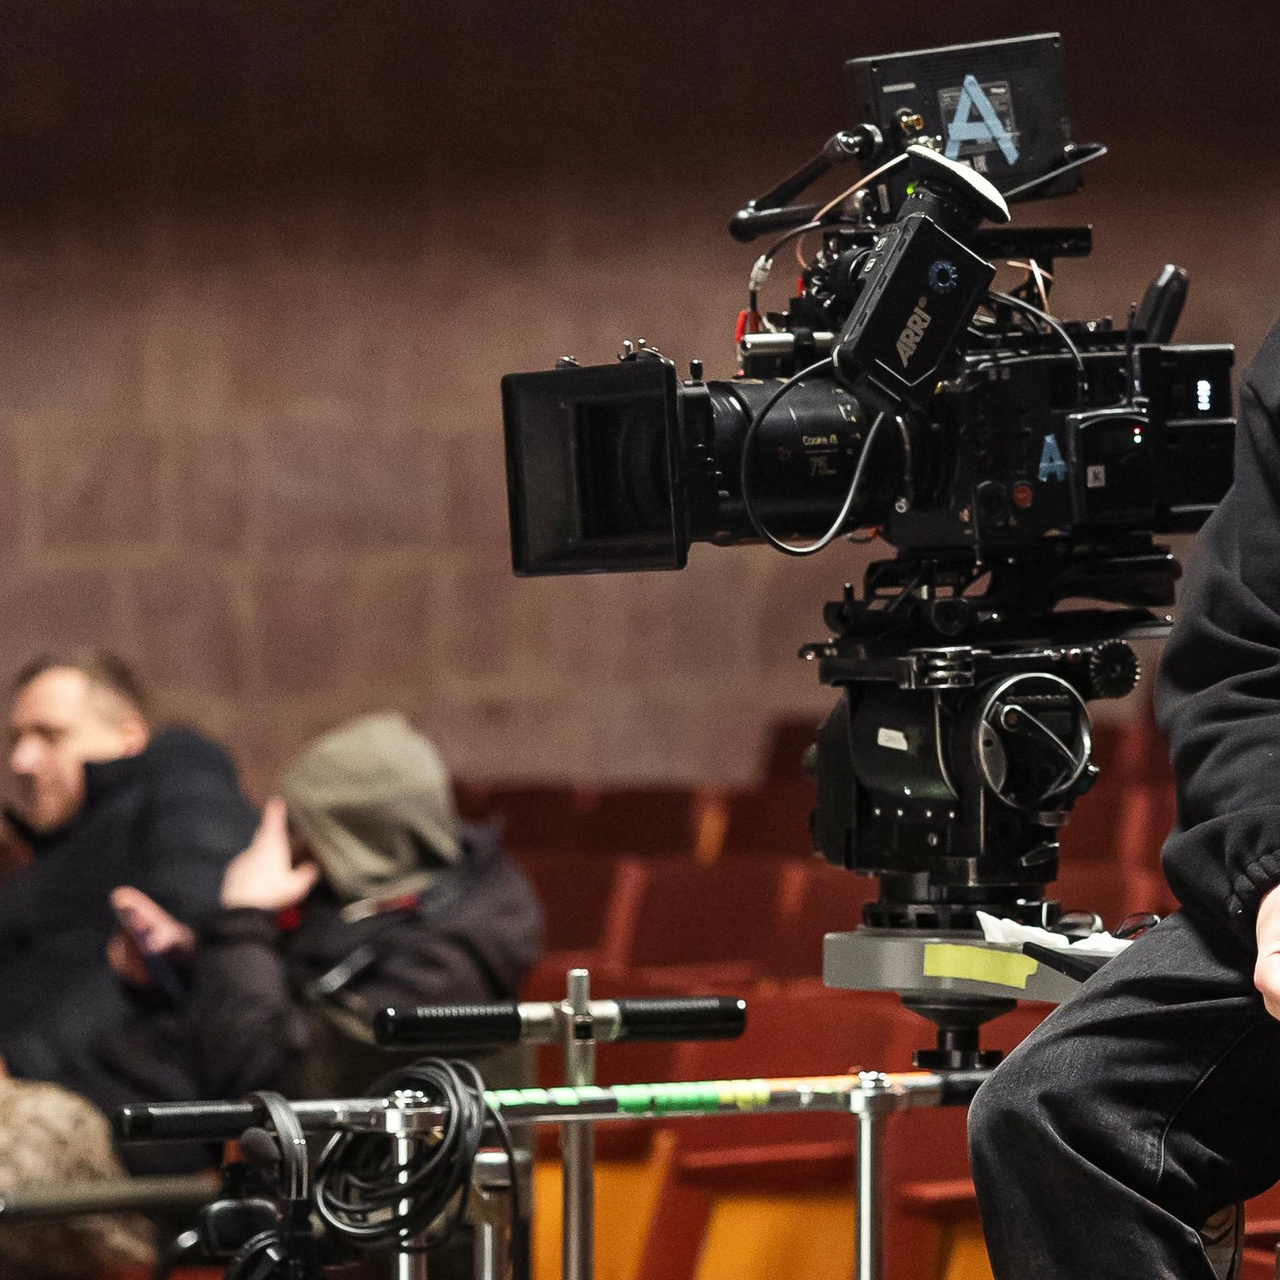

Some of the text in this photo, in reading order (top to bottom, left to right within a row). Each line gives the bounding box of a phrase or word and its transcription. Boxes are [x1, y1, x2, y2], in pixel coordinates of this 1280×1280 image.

[944, 73, 1019, 166] A
[895, 306, 932, 369] ARRI
[1038, 433, 1067, 482] A
